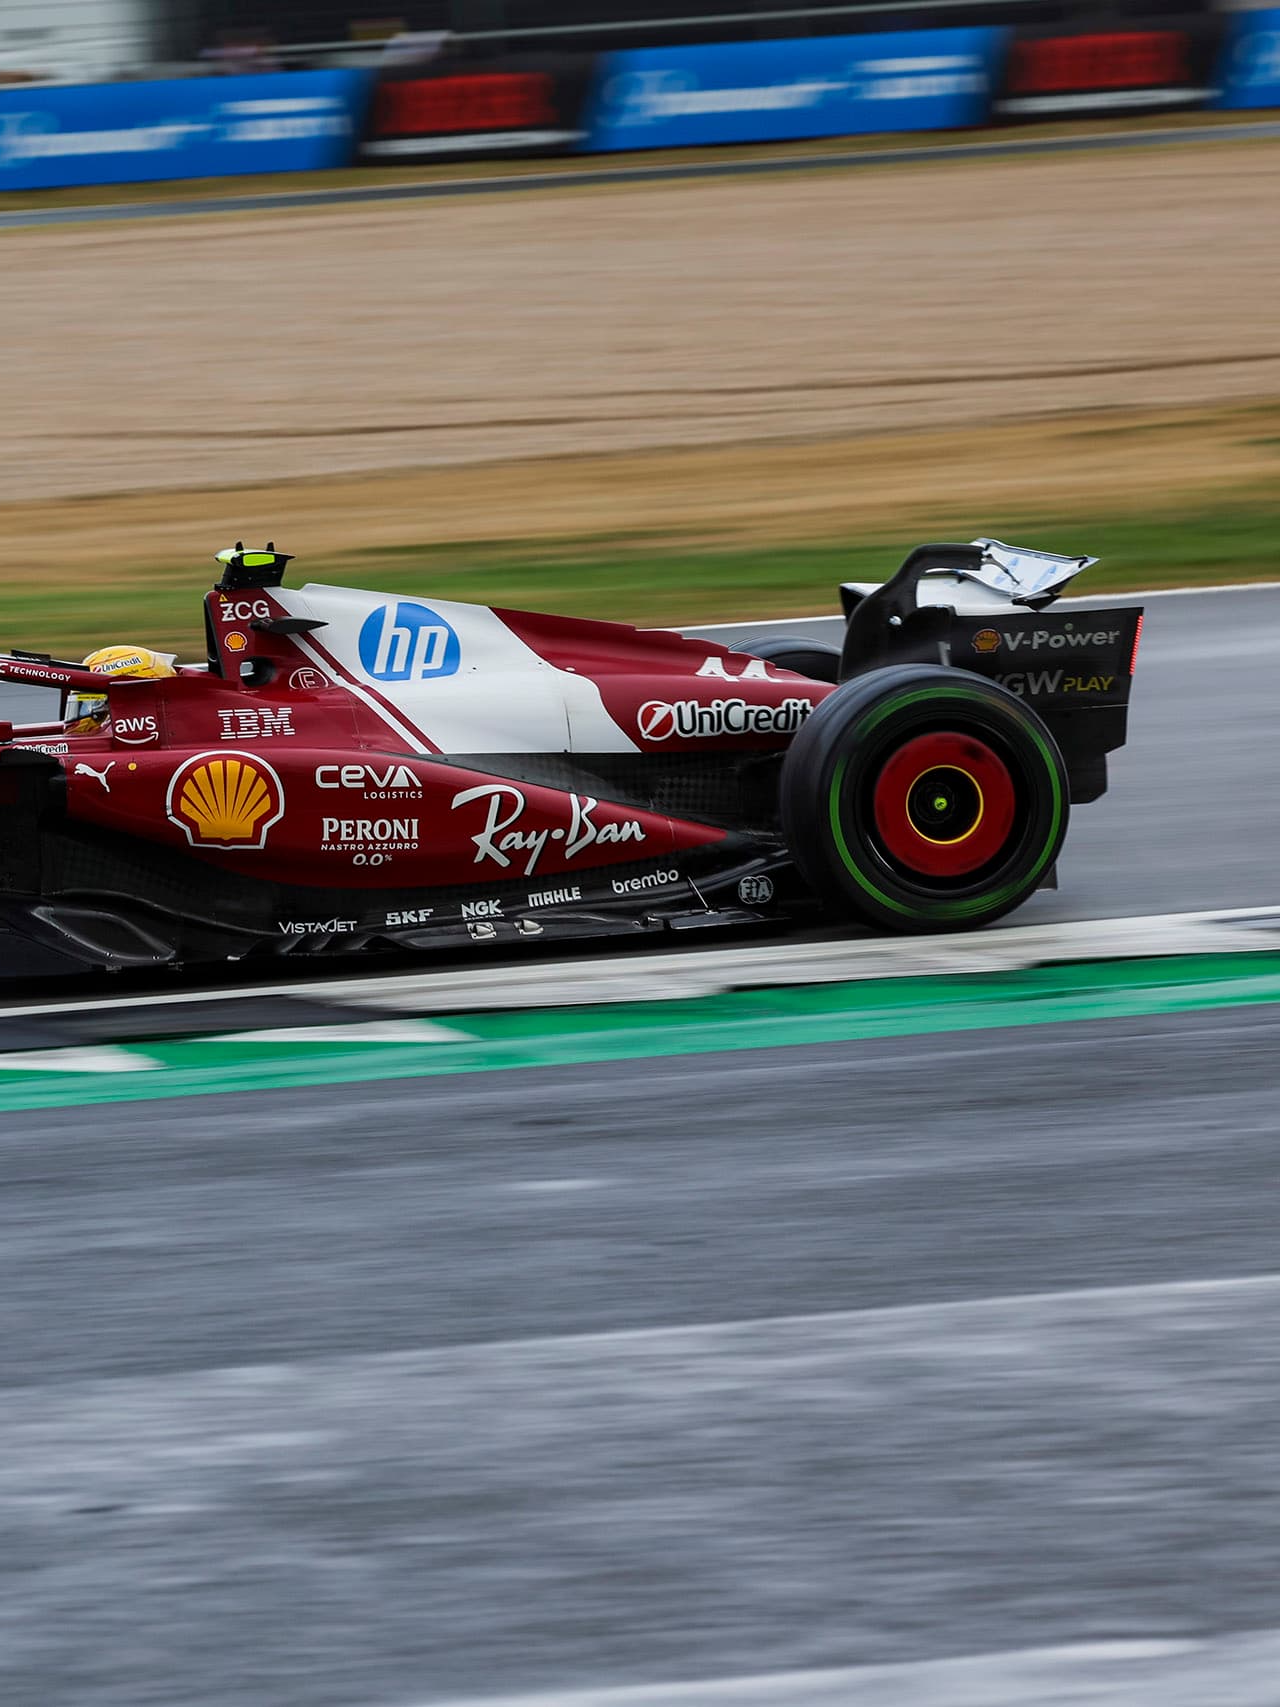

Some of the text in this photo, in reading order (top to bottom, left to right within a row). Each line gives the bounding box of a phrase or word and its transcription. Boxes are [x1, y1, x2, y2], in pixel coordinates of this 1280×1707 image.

[372, 601, 450, 681] hp
[1003, 630, 1121, 651] V-Power
[9, 665, 71, 682] TECHNOLOGY
[1063, 676, 1114, 692] PLAY
[115, 715, 157, 734] aws
[218, 707, 296, 740] IBM
[675, 698, 813, 737] UniCredit
[363, 791, 423, 799] LOGISTICS
[322, 817, 419, 841] PERONI
[321, 843, 365, 851] NASTRO
[612, 869, 679, 895] brembo
[528, 886, 582, 907] MAHLE
[385, 908, 434, 926] SKF
[461, 899, 502, 918] NGK
